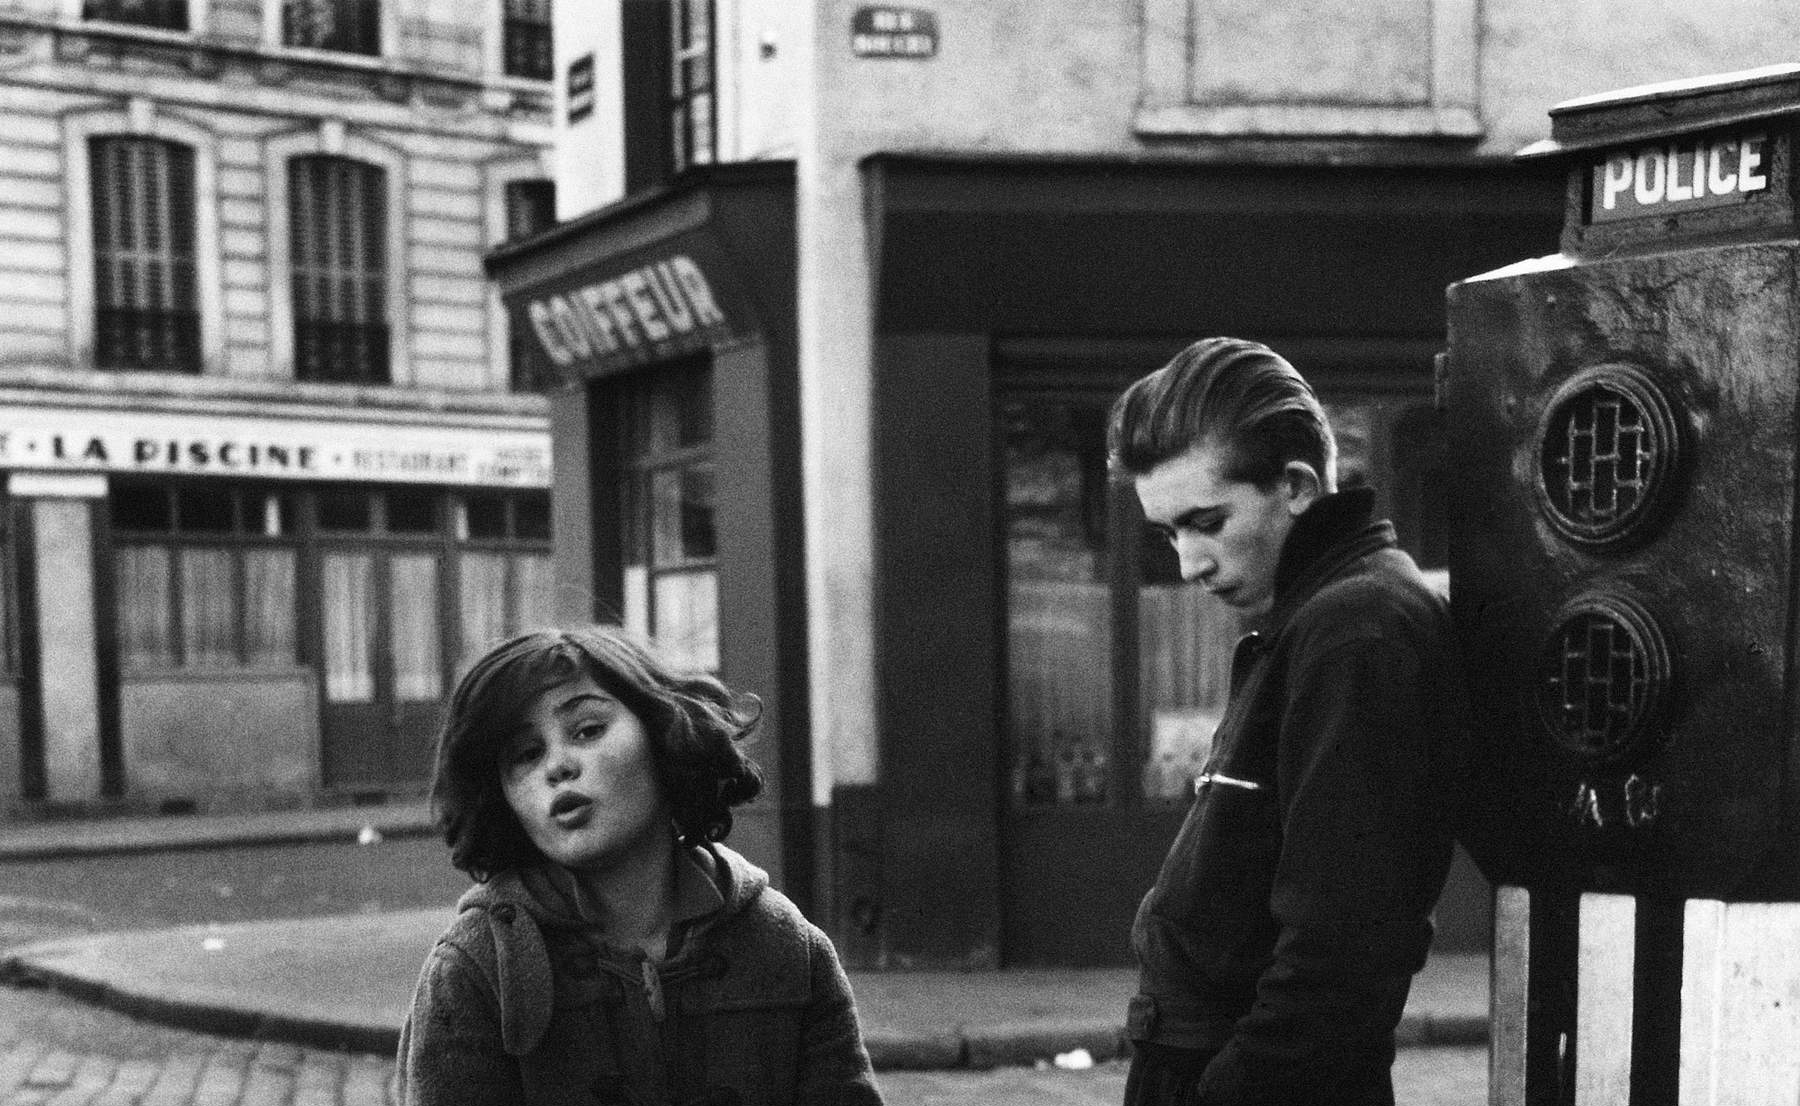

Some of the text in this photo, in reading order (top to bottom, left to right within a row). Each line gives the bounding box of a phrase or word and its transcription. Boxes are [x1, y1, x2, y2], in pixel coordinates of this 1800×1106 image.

[1603, 141, 1767, 209] POLICE
[529, 256, 724, 365] COIFFEUR
[52, 434, 107, 462] LA
[134, 437, 316, 470] PISCINE
